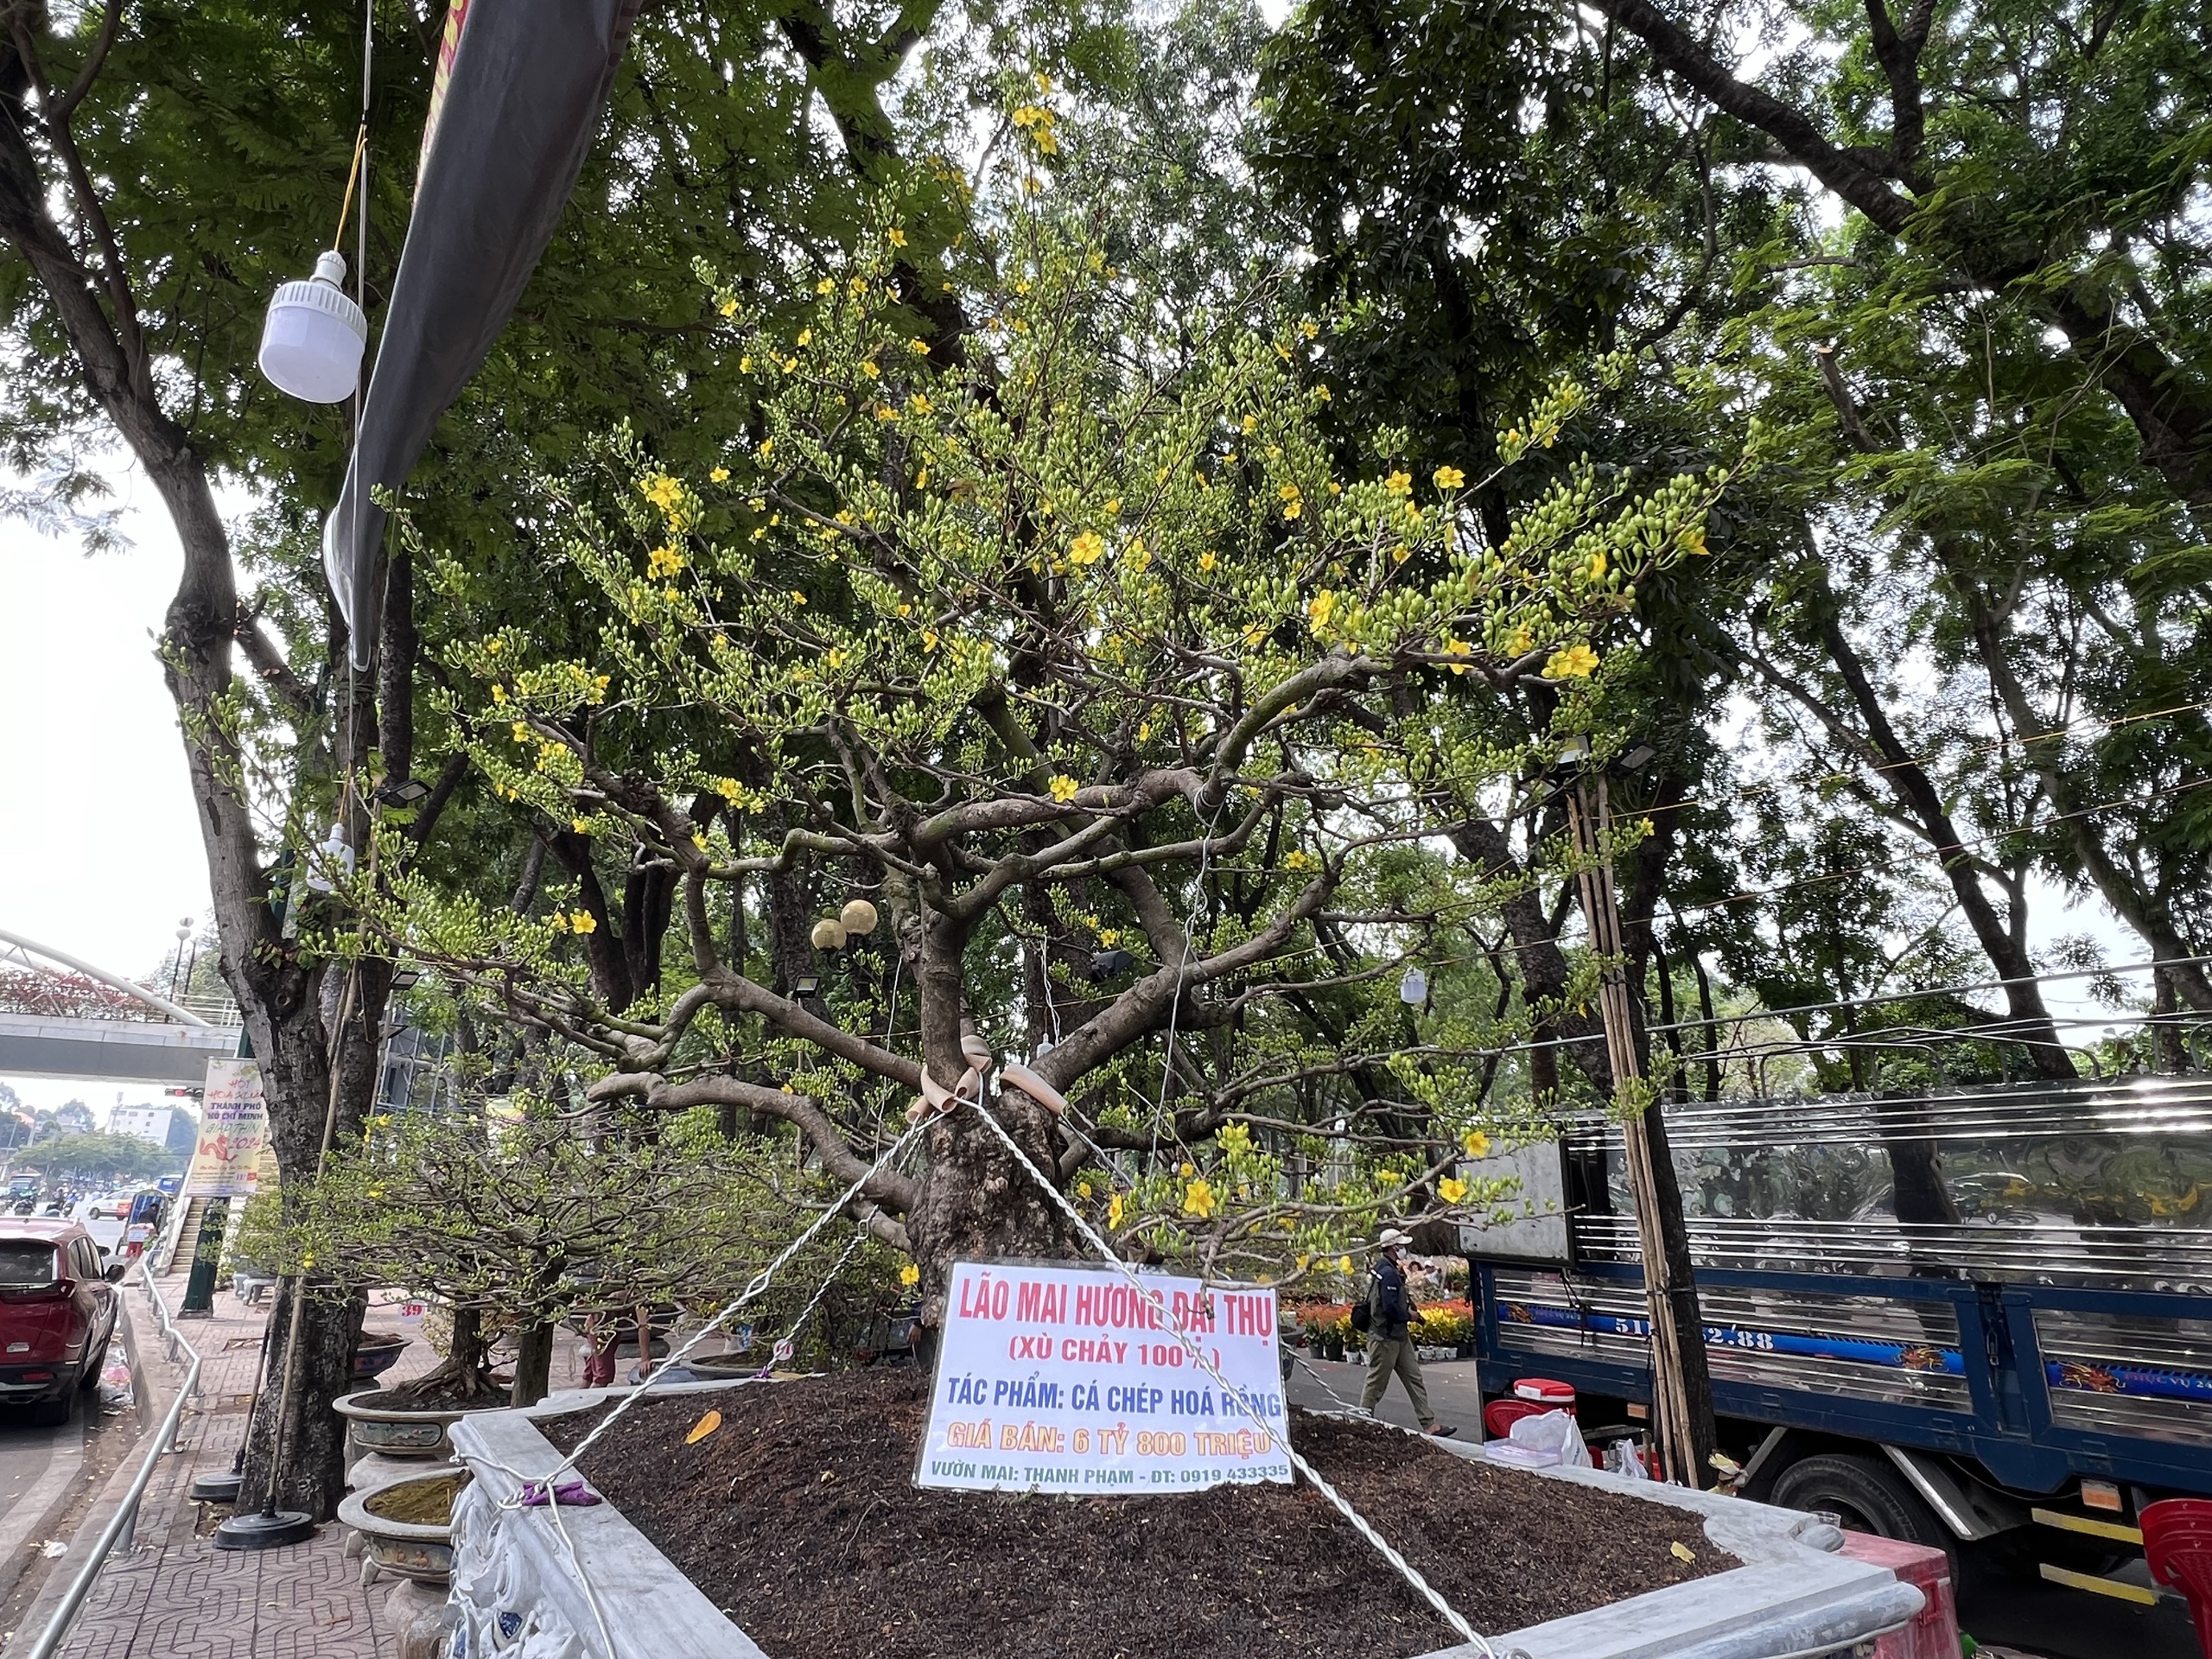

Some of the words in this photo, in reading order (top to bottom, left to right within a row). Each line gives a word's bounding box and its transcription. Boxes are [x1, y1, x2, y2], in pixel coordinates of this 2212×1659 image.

[959, 1271, 1009, 1320] LÃO
[1016, 1281, 1068, 1324] MAI
[1075, 1282, 1164, 1331] HƯƠNG
[1173, 1290, 1215, 1342] ĐẠI
[1224, 1294, 1272, 1346] THỤ
[1009, 1332, 1052, 1361] (XÙ
[1061, 1333, 1128, 1364] CHẢY
[948, 1372, 988, 1405] TÁC
[994, 1371, 1064, 1409] PHẨM:
[1071, 1380, 1100, 1411] CÁ
[1107, 1382, 1163, 1414] CHÉP
[1171, 1386, 1215, 1415] HOÁ
[947, 1419, 992, 1449] GIÁ
[1000, 1421, 1065, 1452] BÁN:
[1073, 1428, 1090, 1454] 6
[1097, 1421, 1129, 1455] TỶ
[1136, 1431, 1186, 1457] 800
[1194, 1428, 1272, 1459] TRIỆU
[931, 1459, 976, 1478] VƯỜN
[981, 1465, 1019, 1481] MAI:
[1024, 1467, 1078, 1484] THANH
[1084, 1469, 1134, 1487] PHẠM
[1151, 1470, 1175, 1483] ĐT:
[1180, 1469, 1222, 1484] 0919
[1227, 1465, 1288, 1480] 433335
